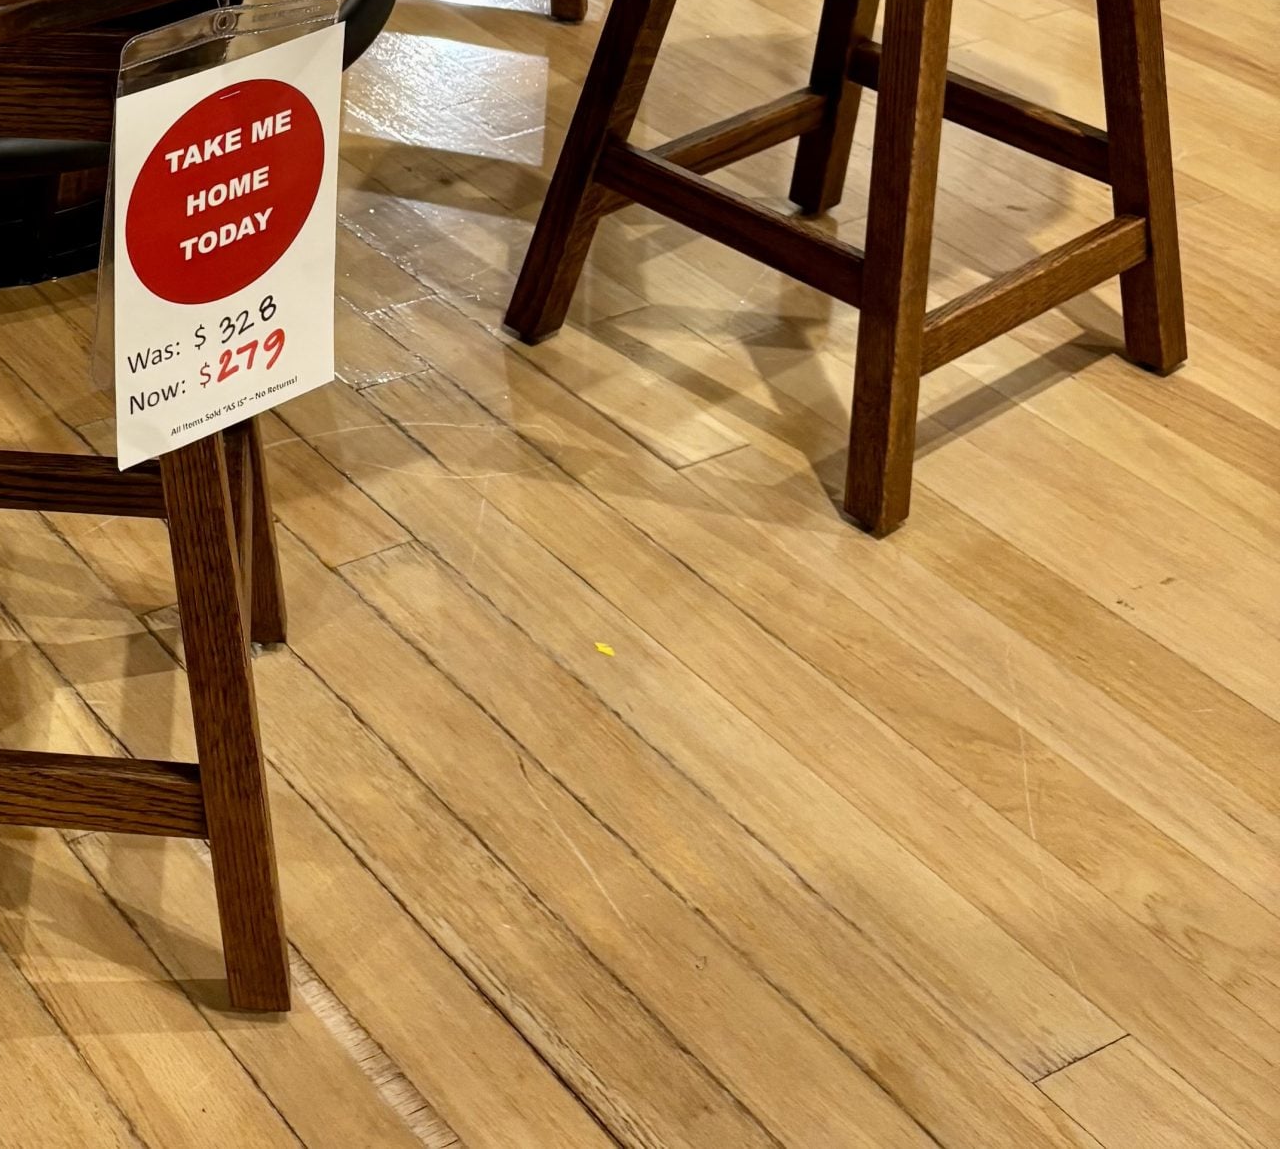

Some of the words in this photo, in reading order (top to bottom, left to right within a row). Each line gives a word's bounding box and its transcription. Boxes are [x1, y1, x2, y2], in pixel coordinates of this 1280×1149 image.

[165, 128, 242, 173] TAKE
[251, 109, 292, 143] ME
[186, 166, 270, 217] HOME
[179, 207, 273, 261] TODAY
[127, 341, 181, 374] Was:
[129, 379, 186, 415] Now:
[170, 425, 181, 436] All
[182, 418, 204, 431] Items
[205, 408, 221, 422] Sold
[255, 390, 266, 400] No
[267, 375, 298, 394] Returns!
